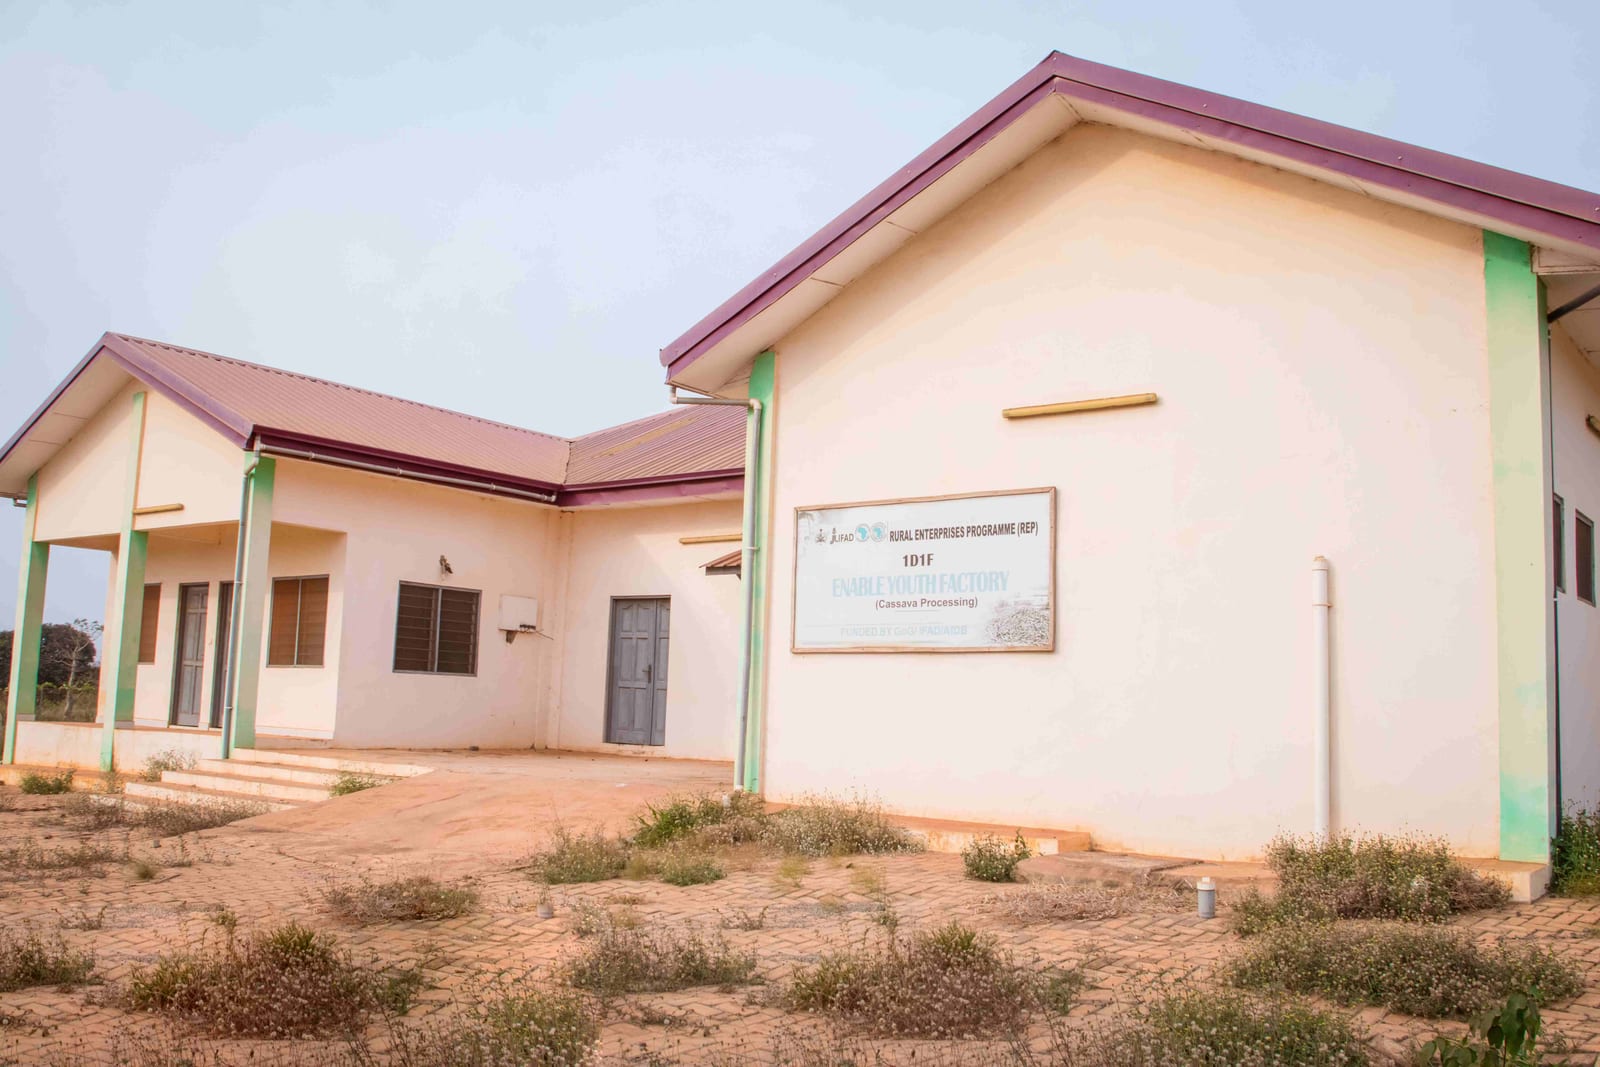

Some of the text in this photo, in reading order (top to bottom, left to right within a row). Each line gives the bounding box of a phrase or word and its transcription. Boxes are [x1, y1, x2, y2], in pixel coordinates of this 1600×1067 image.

[890, 521, 1039, 542] RURAL ENTERPRISES PROGRAMME (REP)
[903, 553, 934, 567] 1D1F
[832, 571, 1009, 597] ENABLE YOUTH FACTORY
[875, 597, 978, 611] (Cassava Processing)
